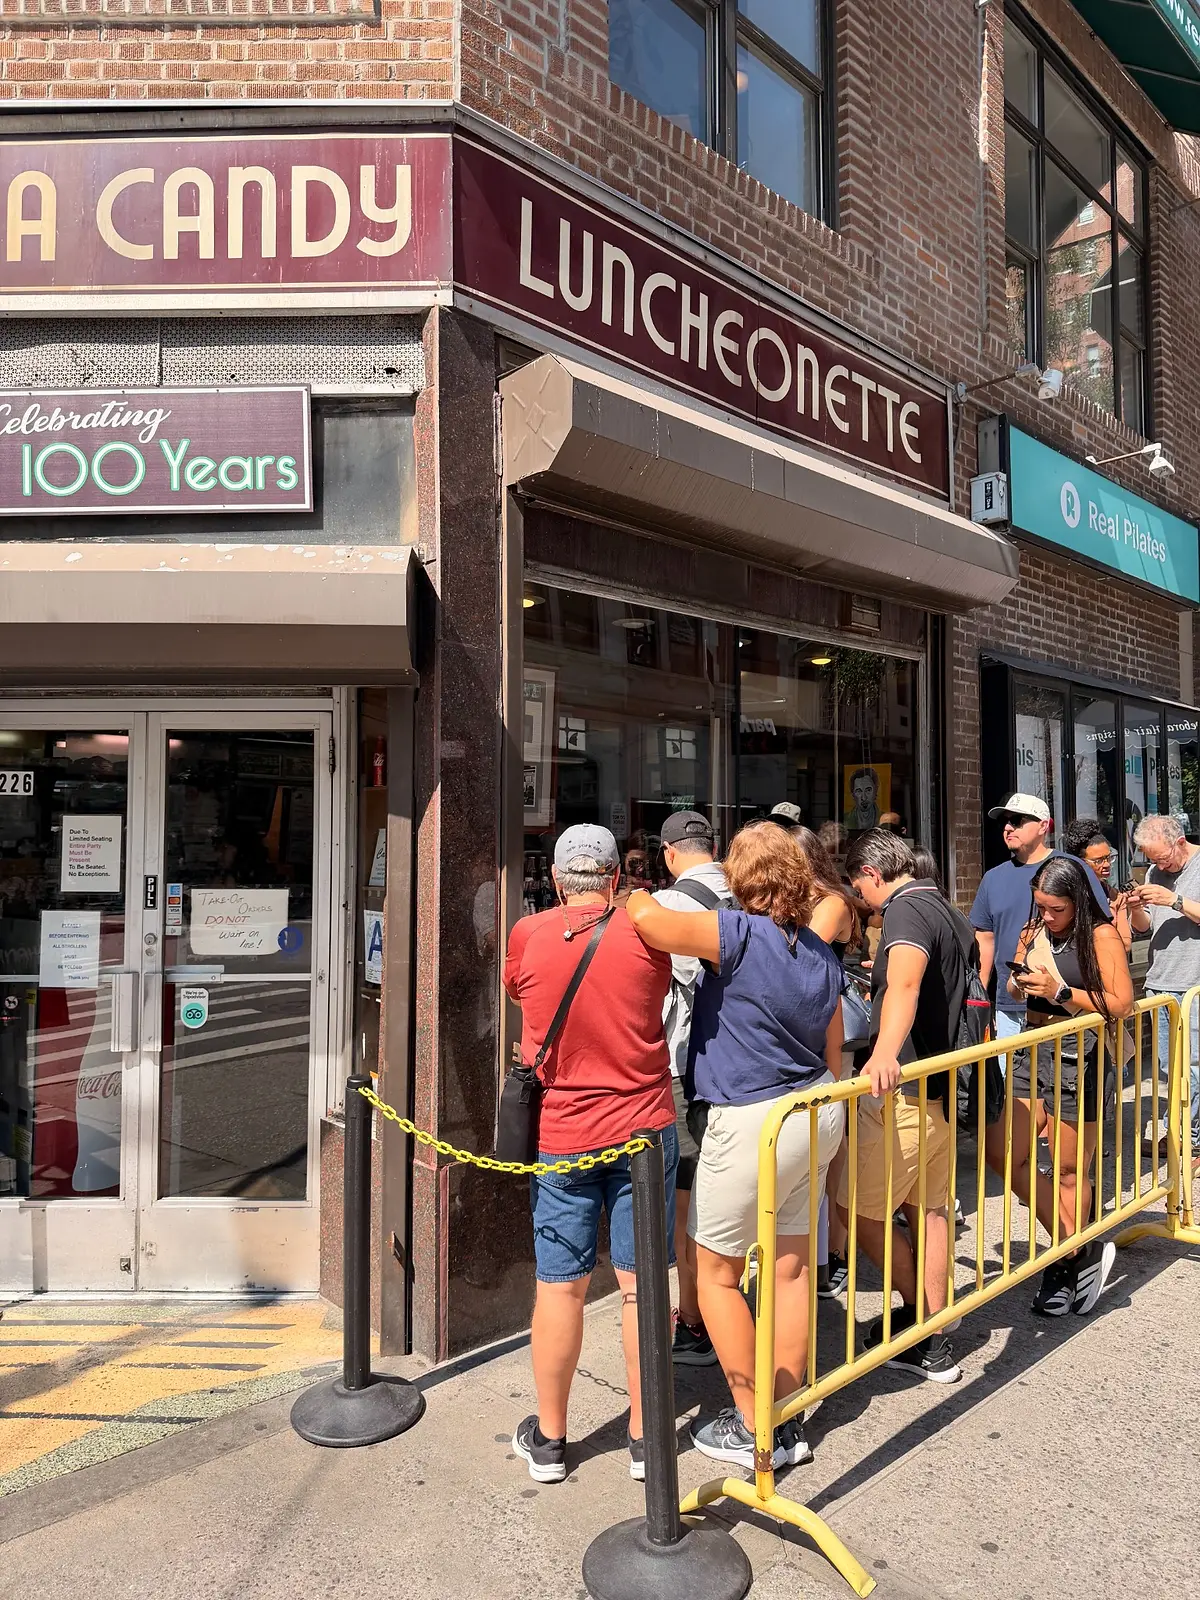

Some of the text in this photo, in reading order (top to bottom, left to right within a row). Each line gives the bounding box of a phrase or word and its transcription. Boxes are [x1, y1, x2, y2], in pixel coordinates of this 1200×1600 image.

[6, 164, 412, 262] A CANDY
[519, 196, 922, 464] LUNCHEONETTE
[22, 438, 299, 497] 100 Years
[1088, 500, 1120, 541] Real
[1123, 518, 1166, 563] Pilates
[0, 773, 32, 793] 226
[147, 877, 155, 907] PULL
[204, 915, 251, 925] DO NOT
